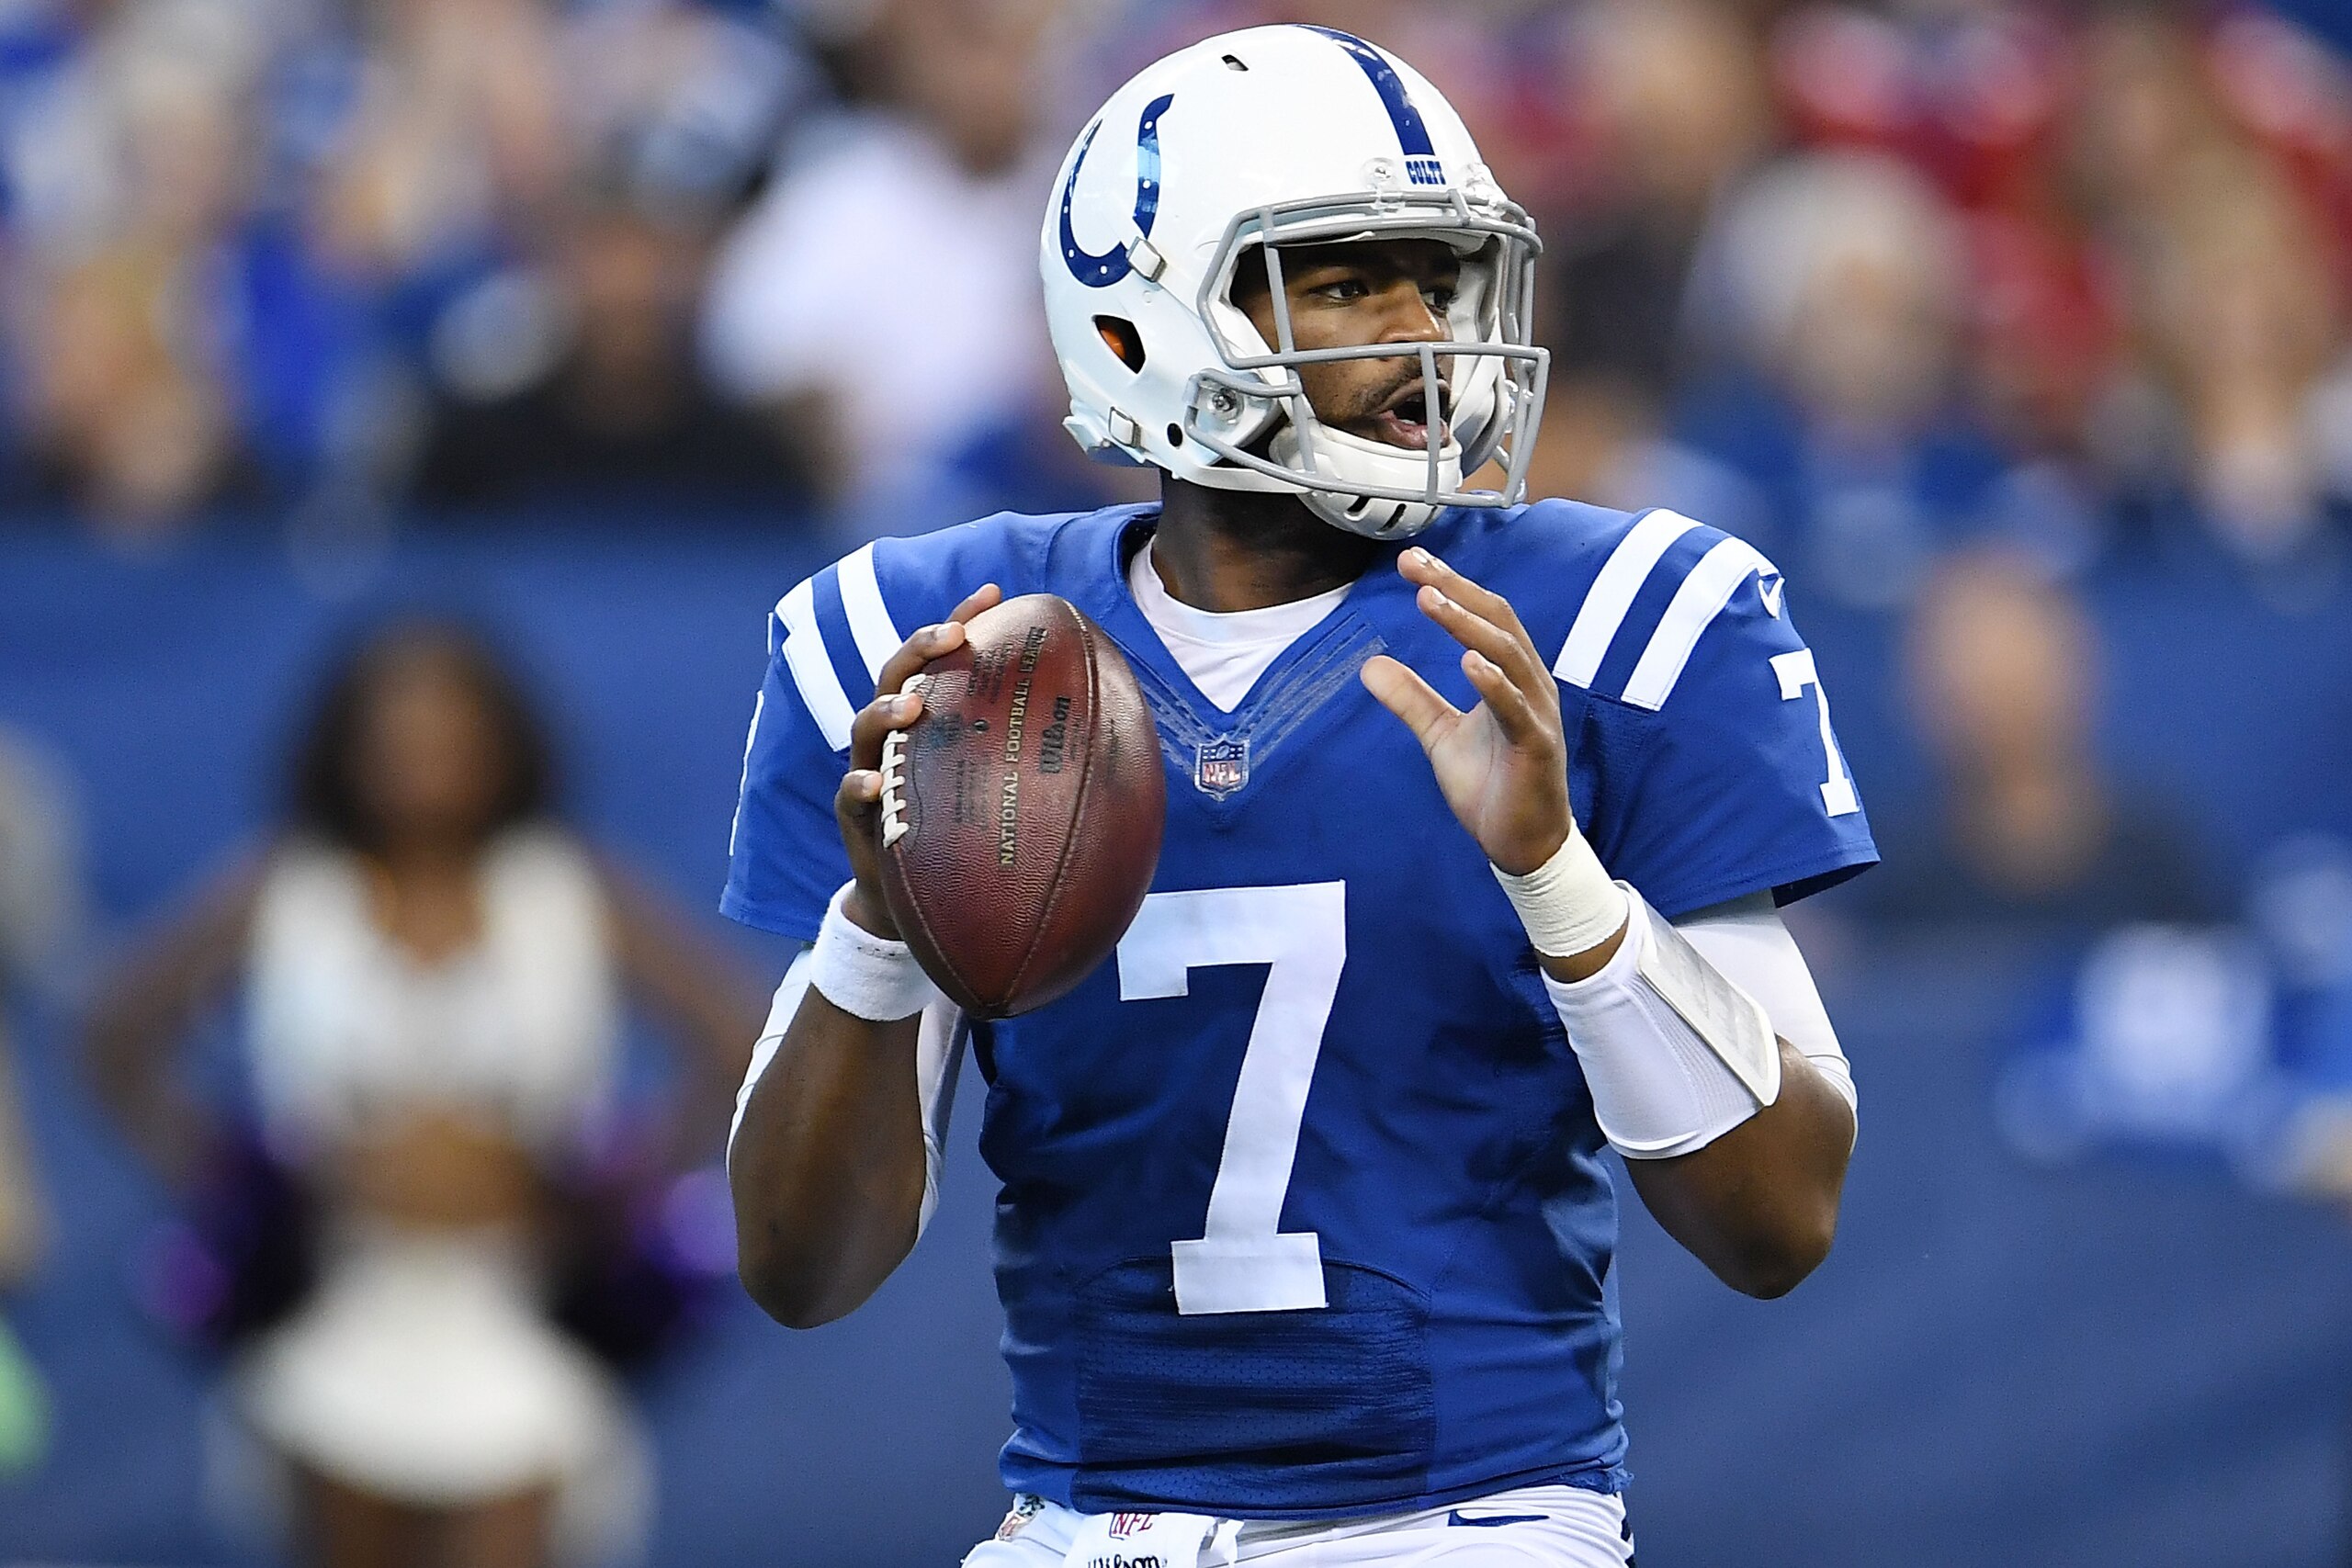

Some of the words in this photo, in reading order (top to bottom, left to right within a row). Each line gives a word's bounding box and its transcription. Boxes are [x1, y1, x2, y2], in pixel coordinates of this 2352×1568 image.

[1406, 161, 1446, 185] COLTS
[1019, 626, 1048, 673] LEAGUE
[1005, 678, 1032, 763] FOOTBALL
[1039, 697, 1071, 773] Wilson
[1770, 647, 1860, 817] 7
[1203, 762, 1242, 784] NFL
[999, 772, 1019, 866] NATIONAL
[1116, 879, 1348, 1315] 7
